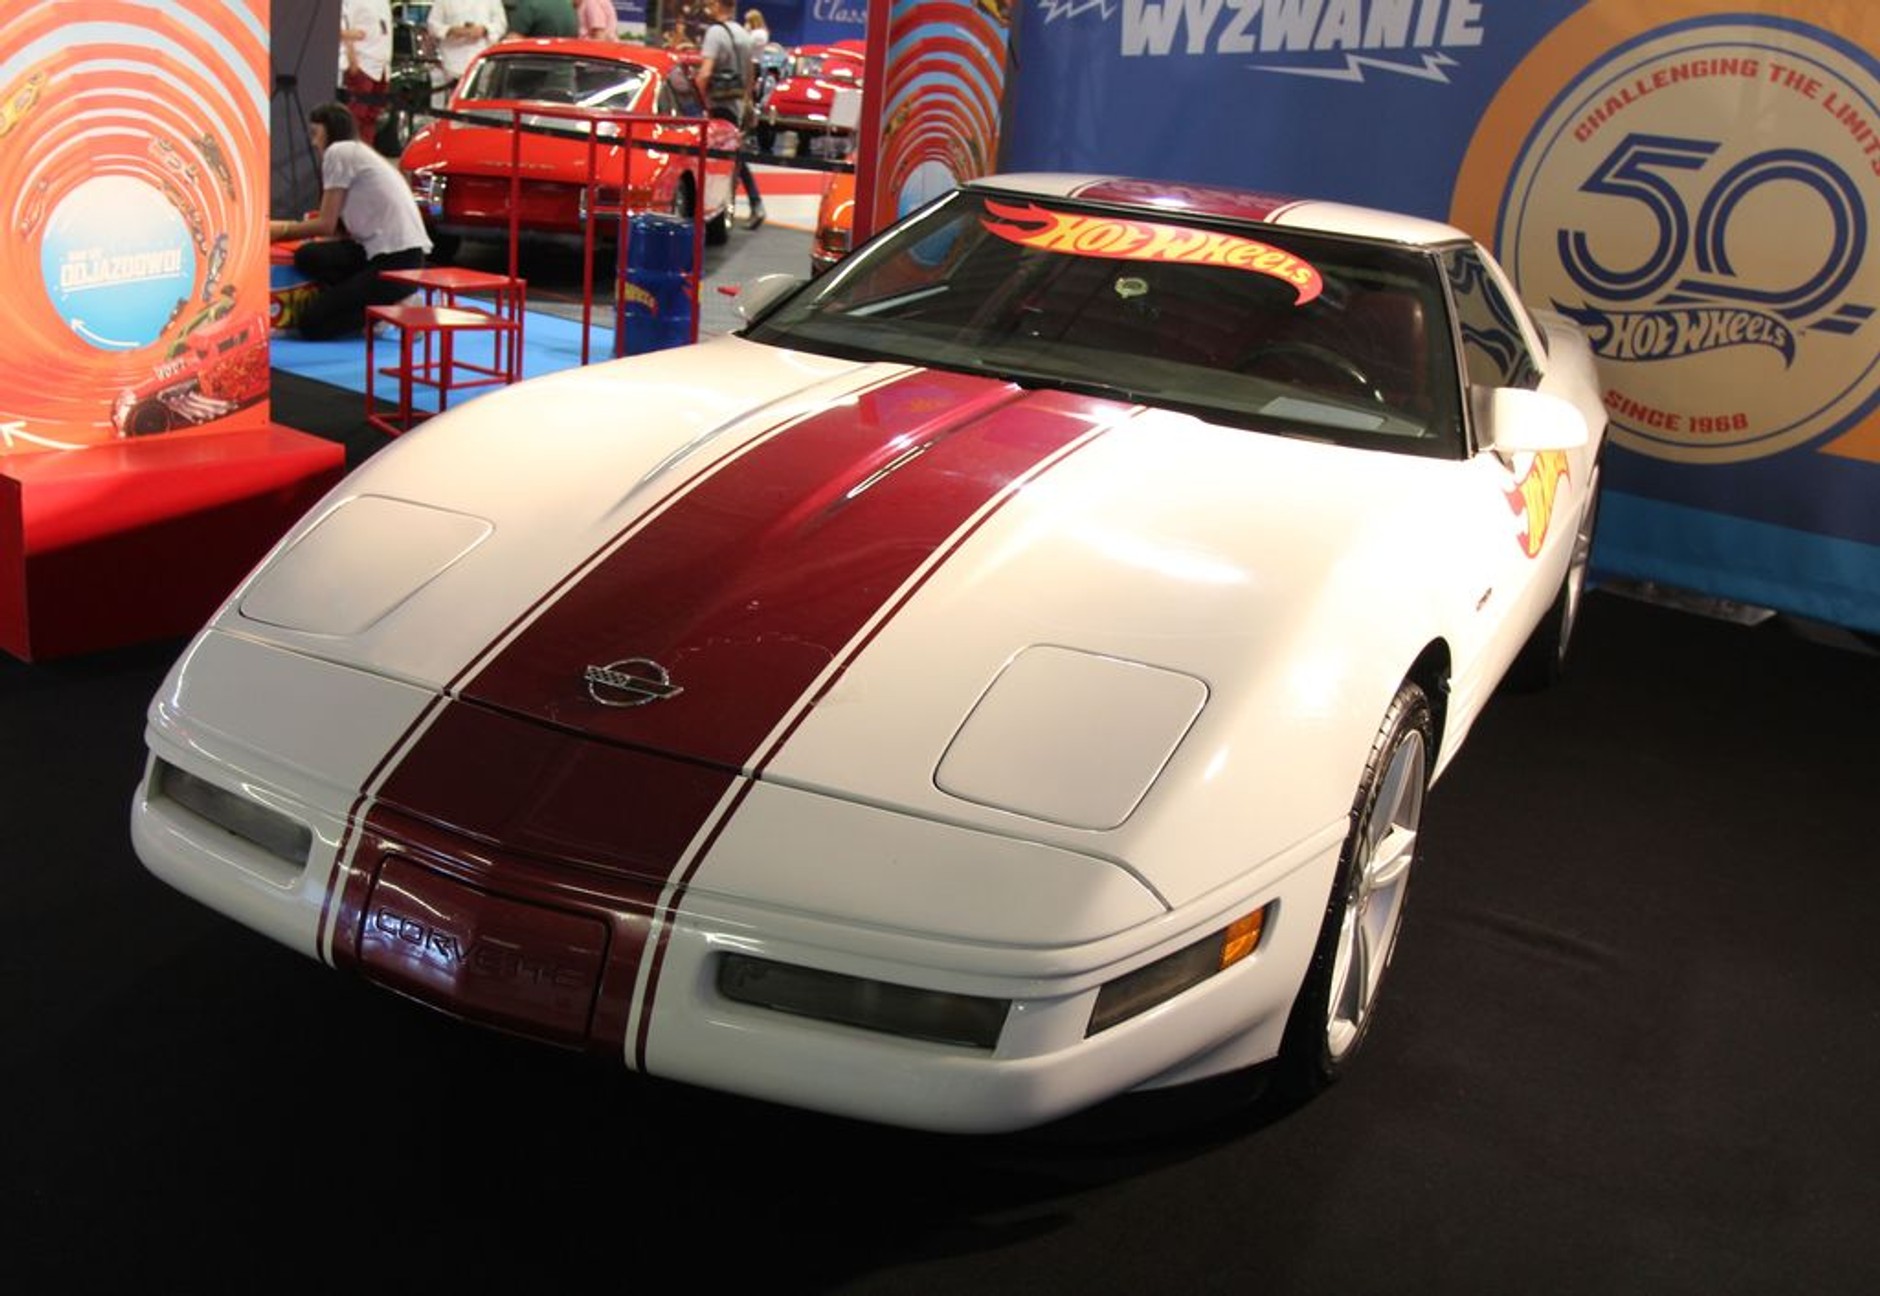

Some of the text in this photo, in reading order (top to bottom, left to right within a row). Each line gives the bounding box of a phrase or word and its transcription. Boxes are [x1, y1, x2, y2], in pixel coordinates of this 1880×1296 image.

[1121, 0, 1486, 56] WYZWANIE
[1573, 58, 1760, 143] CHALLENGING
[1769, 63, 1823, 100] THE
[1557, 133, 1867, 320] 50
[1603, 389, 1749, 433] SINCE 1968
[375, 906, 586, 986] CORVETTE
